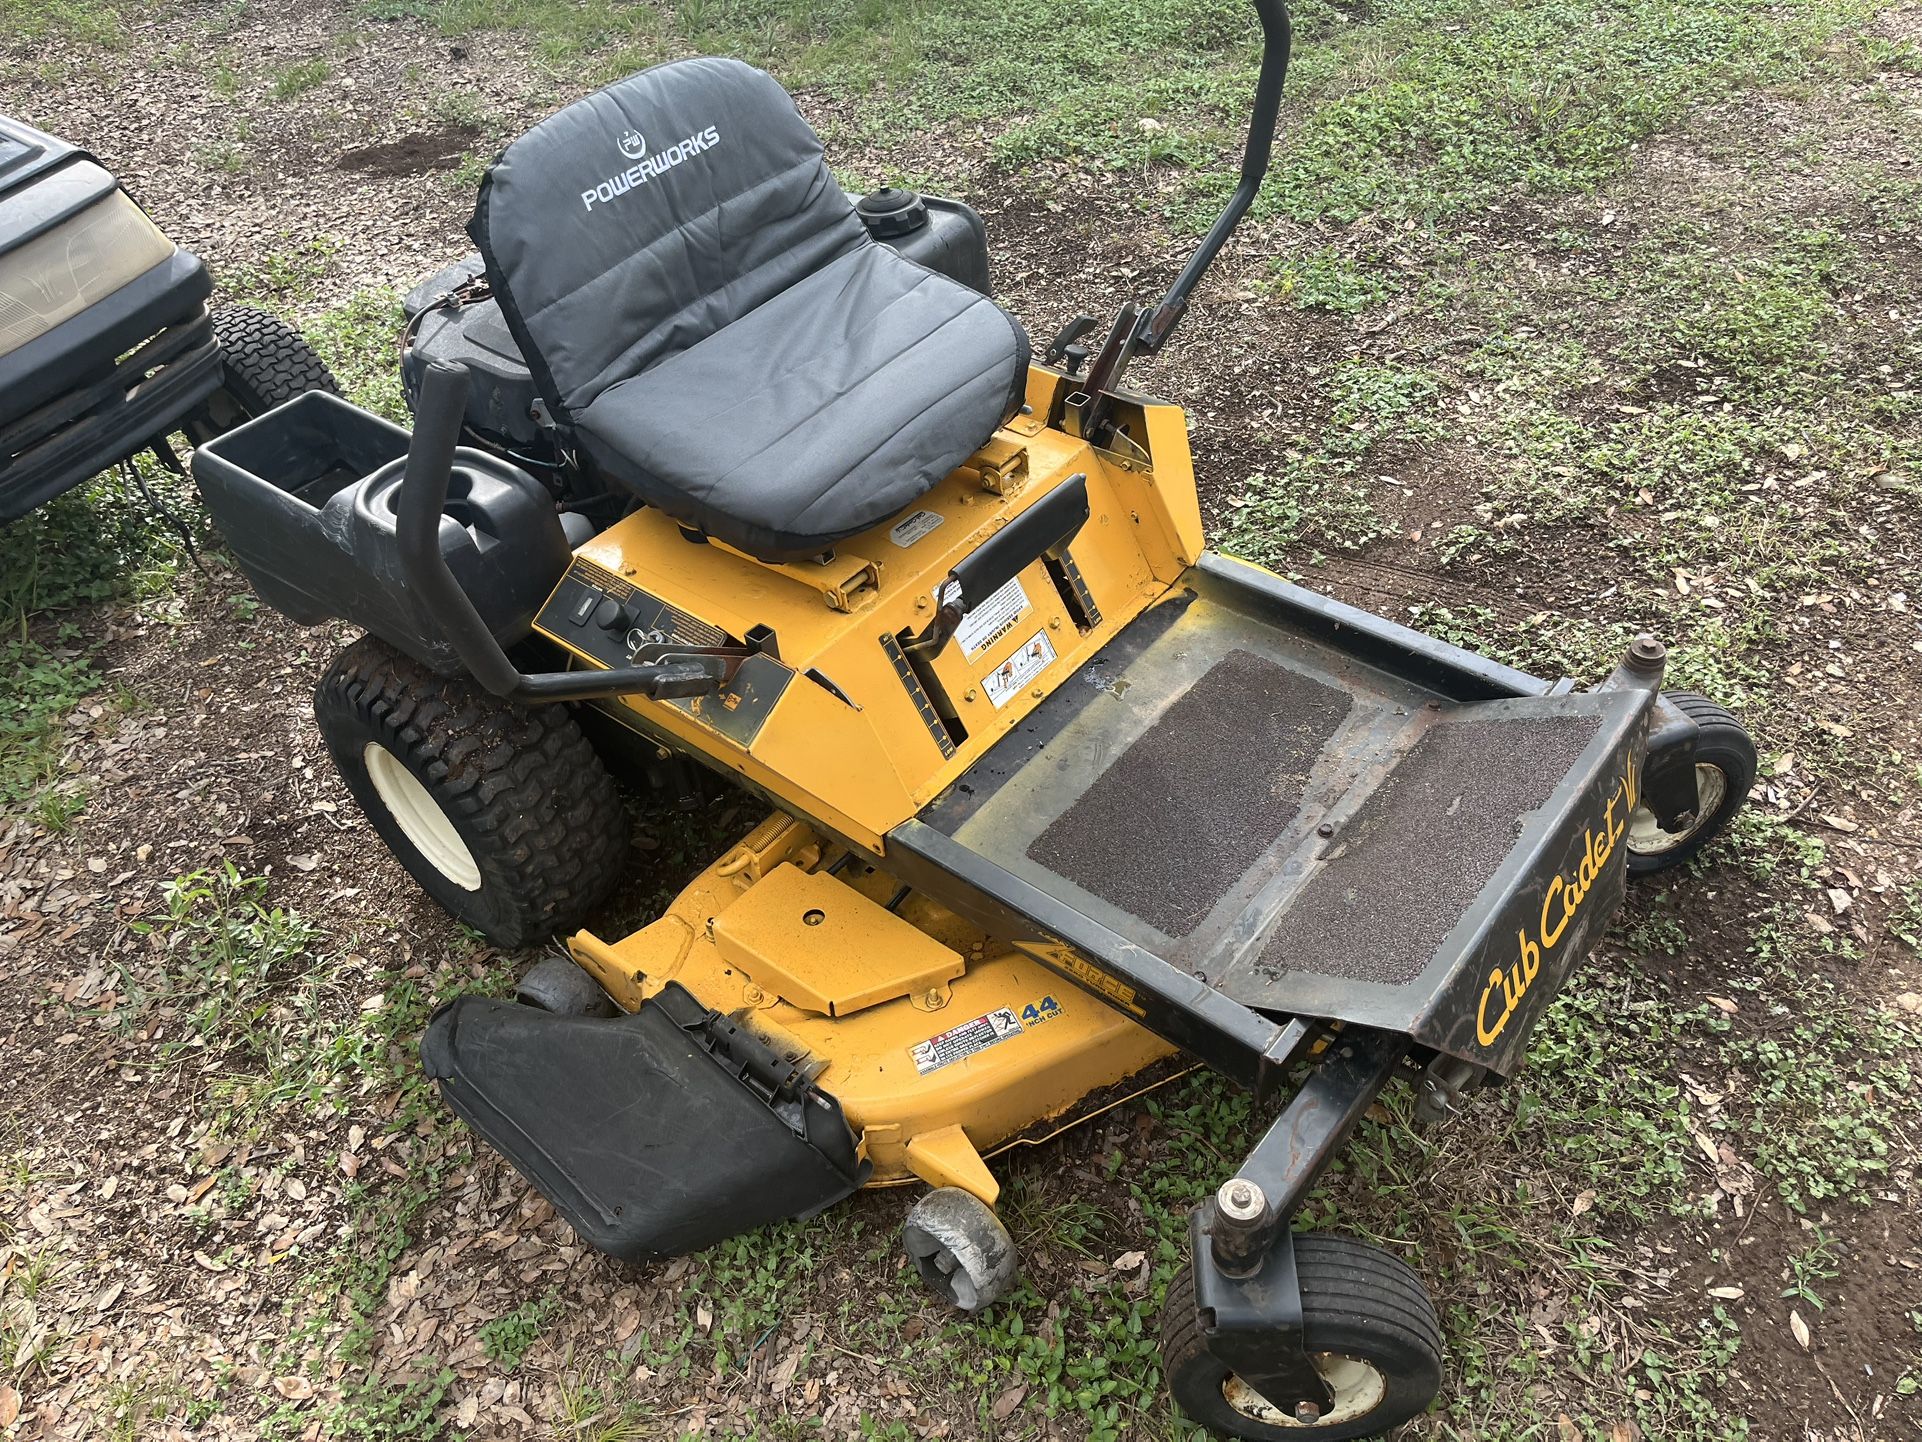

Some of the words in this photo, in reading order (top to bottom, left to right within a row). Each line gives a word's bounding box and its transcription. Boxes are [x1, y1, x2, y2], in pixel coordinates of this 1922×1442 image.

[581, 125, 721, 212] POWERWORKS
[981, 621, 1013, 651] WARNING
[1477, 929, 1540, 1047] Cub
[1540, 783, 1626, 949] Cadet
[1022, 995, 1058, 1020] 44
[1026, 1015, 1046, 1028] NCH
[1048, 1008, 1064, 1019] CUT
[944, 1019, 981, 1038] DANGER
